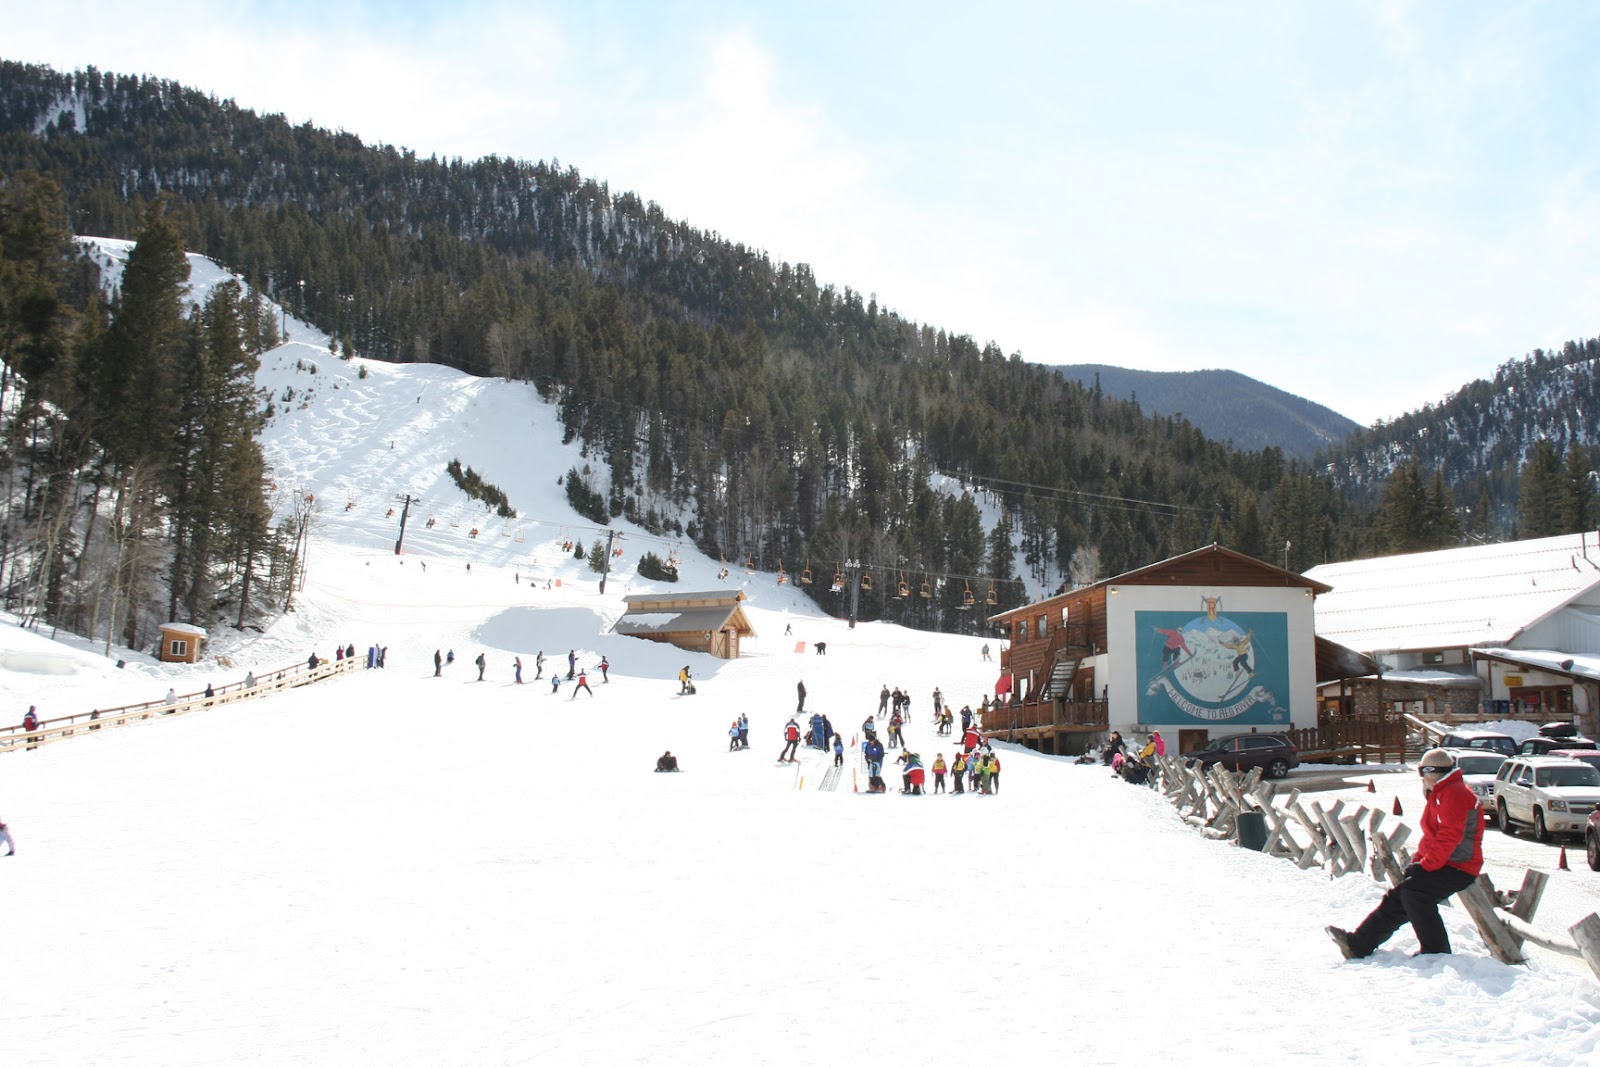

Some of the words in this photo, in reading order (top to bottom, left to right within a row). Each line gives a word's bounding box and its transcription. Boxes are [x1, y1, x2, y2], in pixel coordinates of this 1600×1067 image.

[1168, 688, 1203, 718] WELCOME
[1207, 710, 1217, 719] TO
[1219, 707, 1235, 719] RED
[1234, 695, 1255, 713] RIVER
